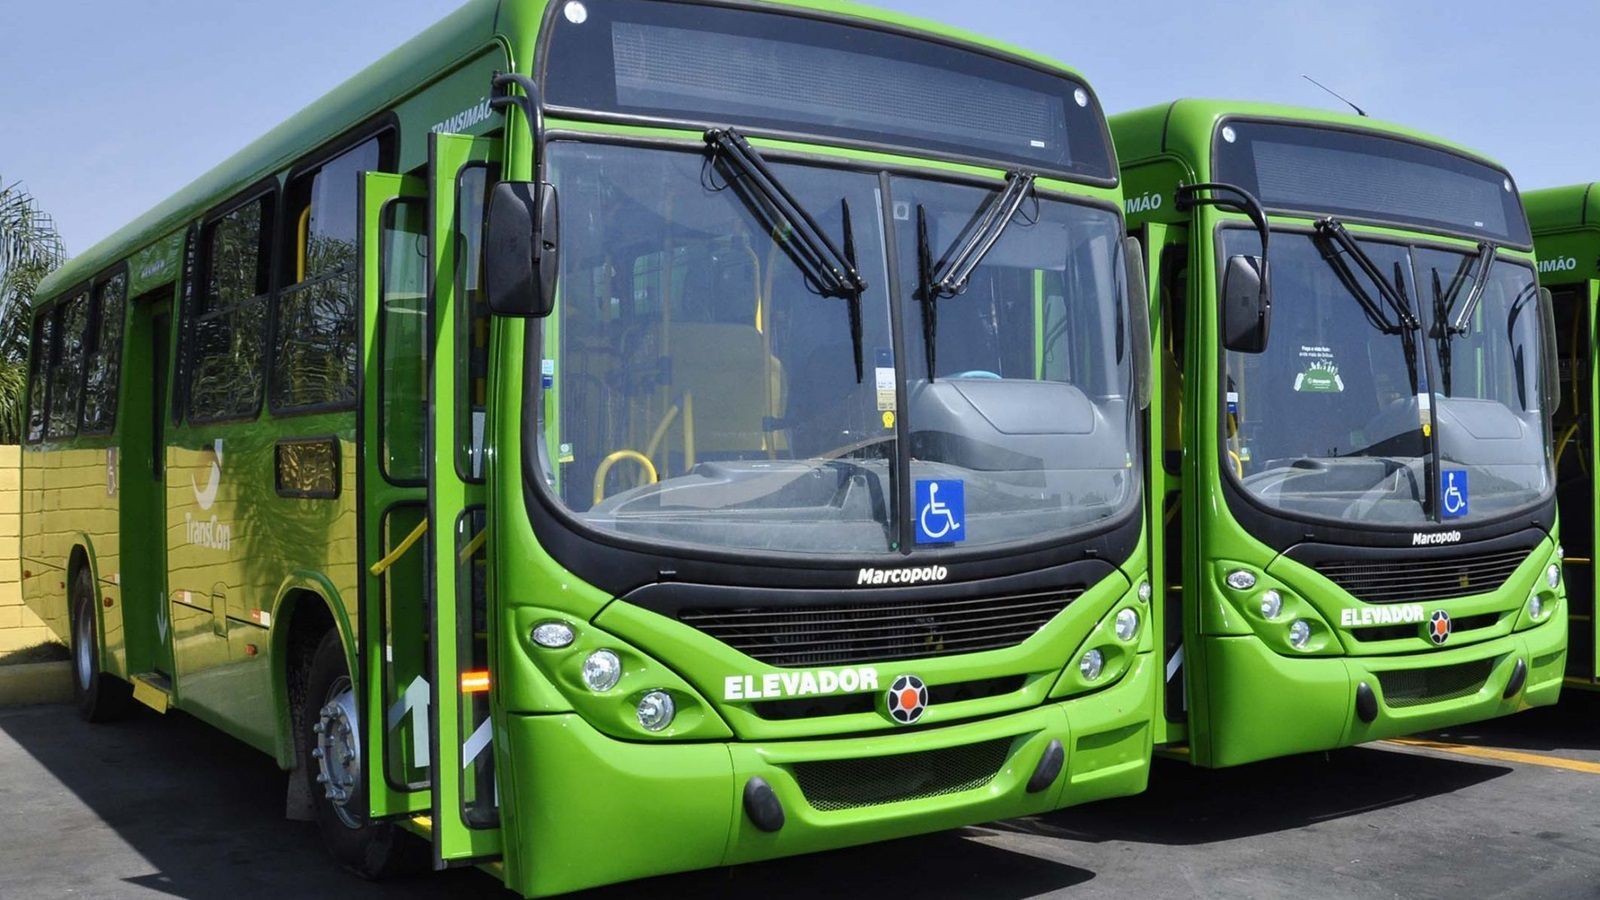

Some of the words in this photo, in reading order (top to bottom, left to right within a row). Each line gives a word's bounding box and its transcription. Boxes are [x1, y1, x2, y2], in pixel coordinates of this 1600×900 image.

[1536, 255, 1576, 273] IMÃO
[185, 512, 231, 551] TransCon
[1412, 530, 1461, 546] Marcopolo
[857, 565, 948, 585] Marcopolo
[1340, 605, 1424, 626] ELEVADOR
[724, 667, 879, 700] ELEVADOR
